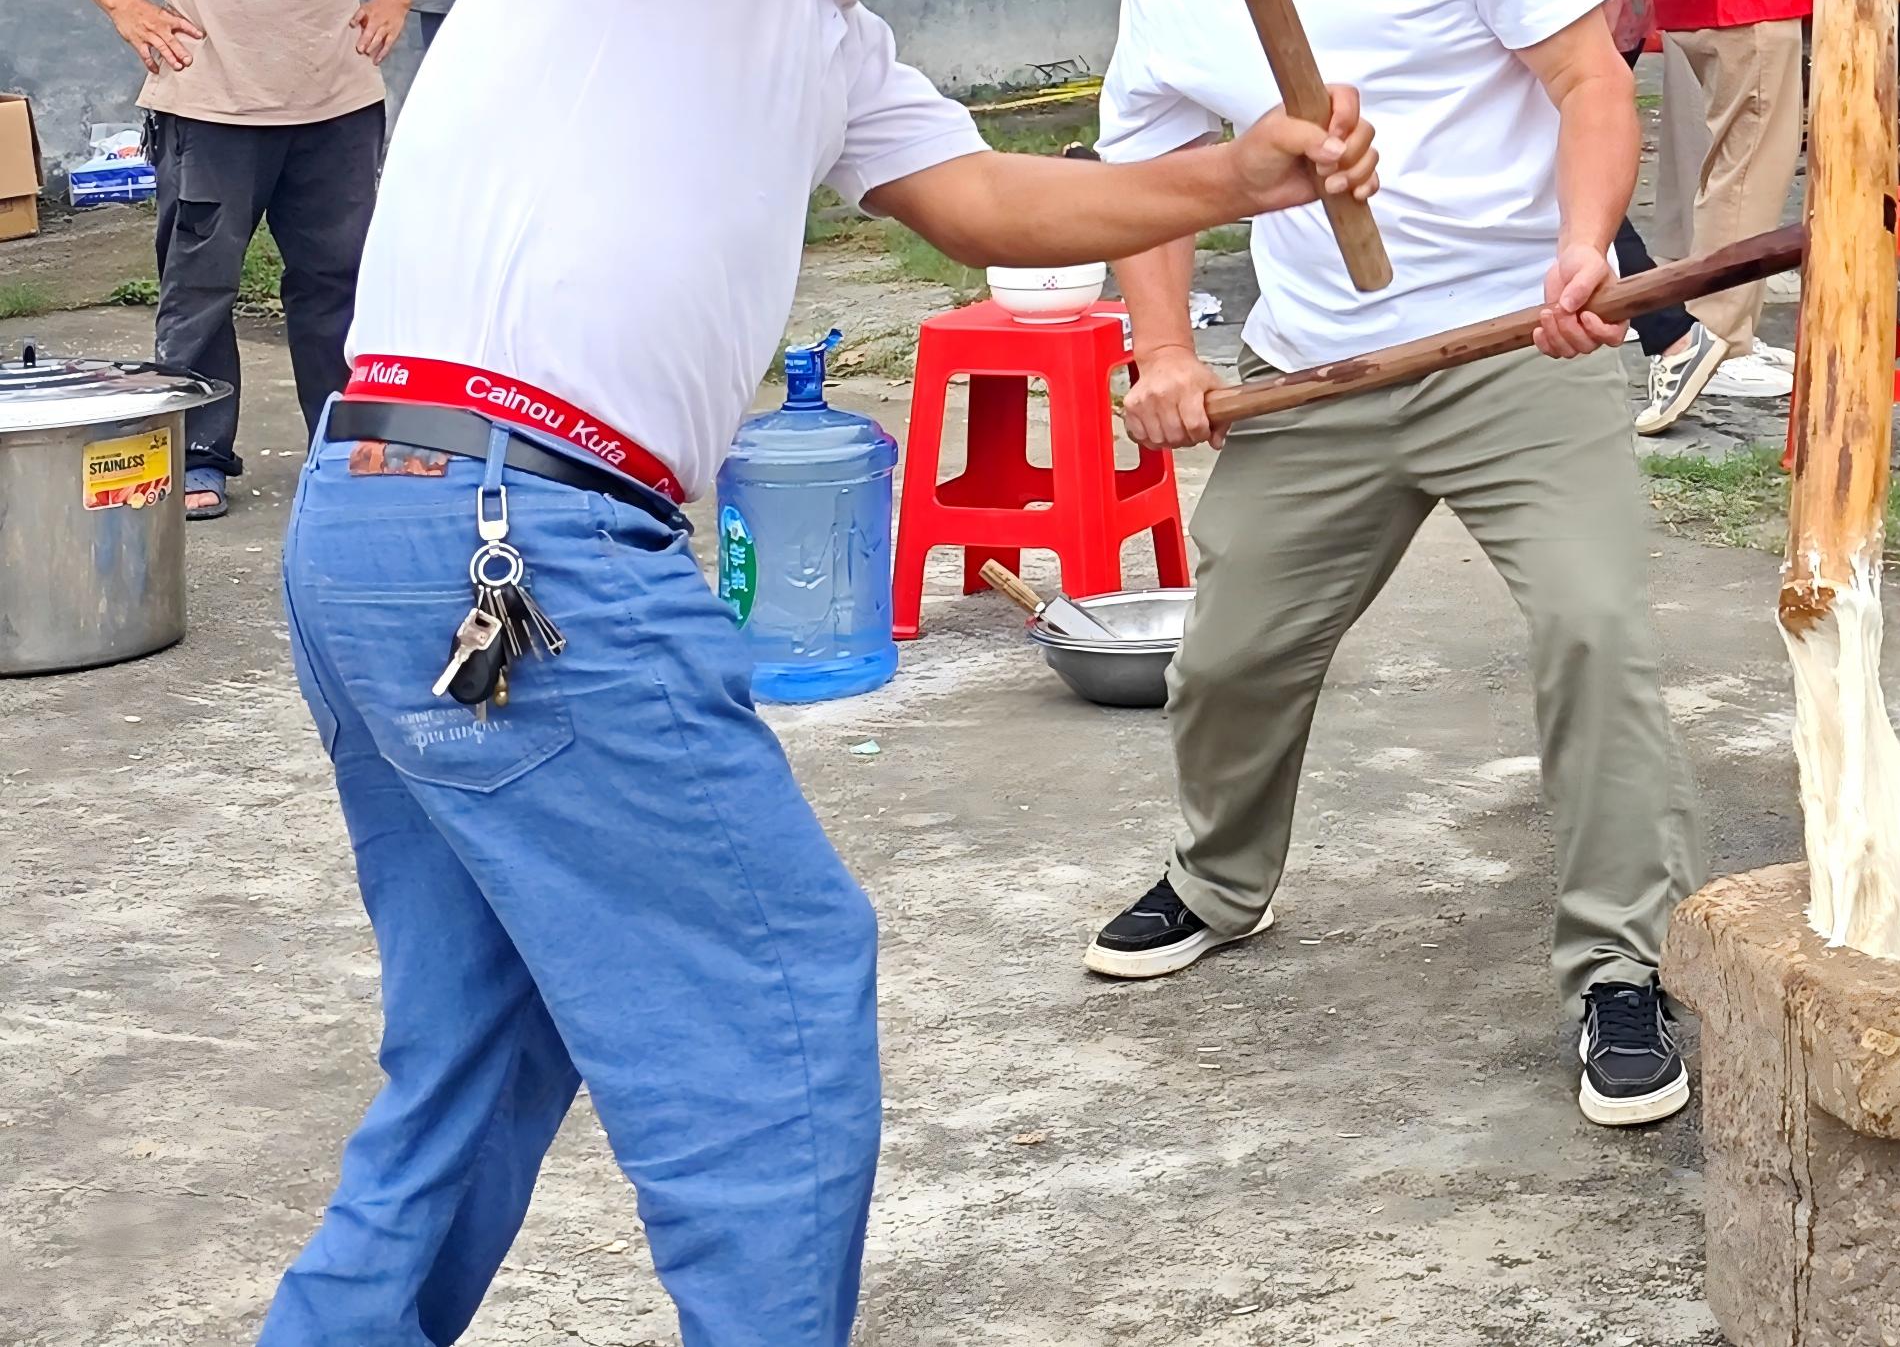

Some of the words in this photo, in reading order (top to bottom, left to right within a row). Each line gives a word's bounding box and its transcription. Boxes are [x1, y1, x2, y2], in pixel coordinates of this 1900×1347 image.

[368, 361, 410, 386] Kufa
[465, 375, 566, 430] Cainou
[568, 419, 627, 466] Kufa
[89, 453, 145, 475] STAINLESS
